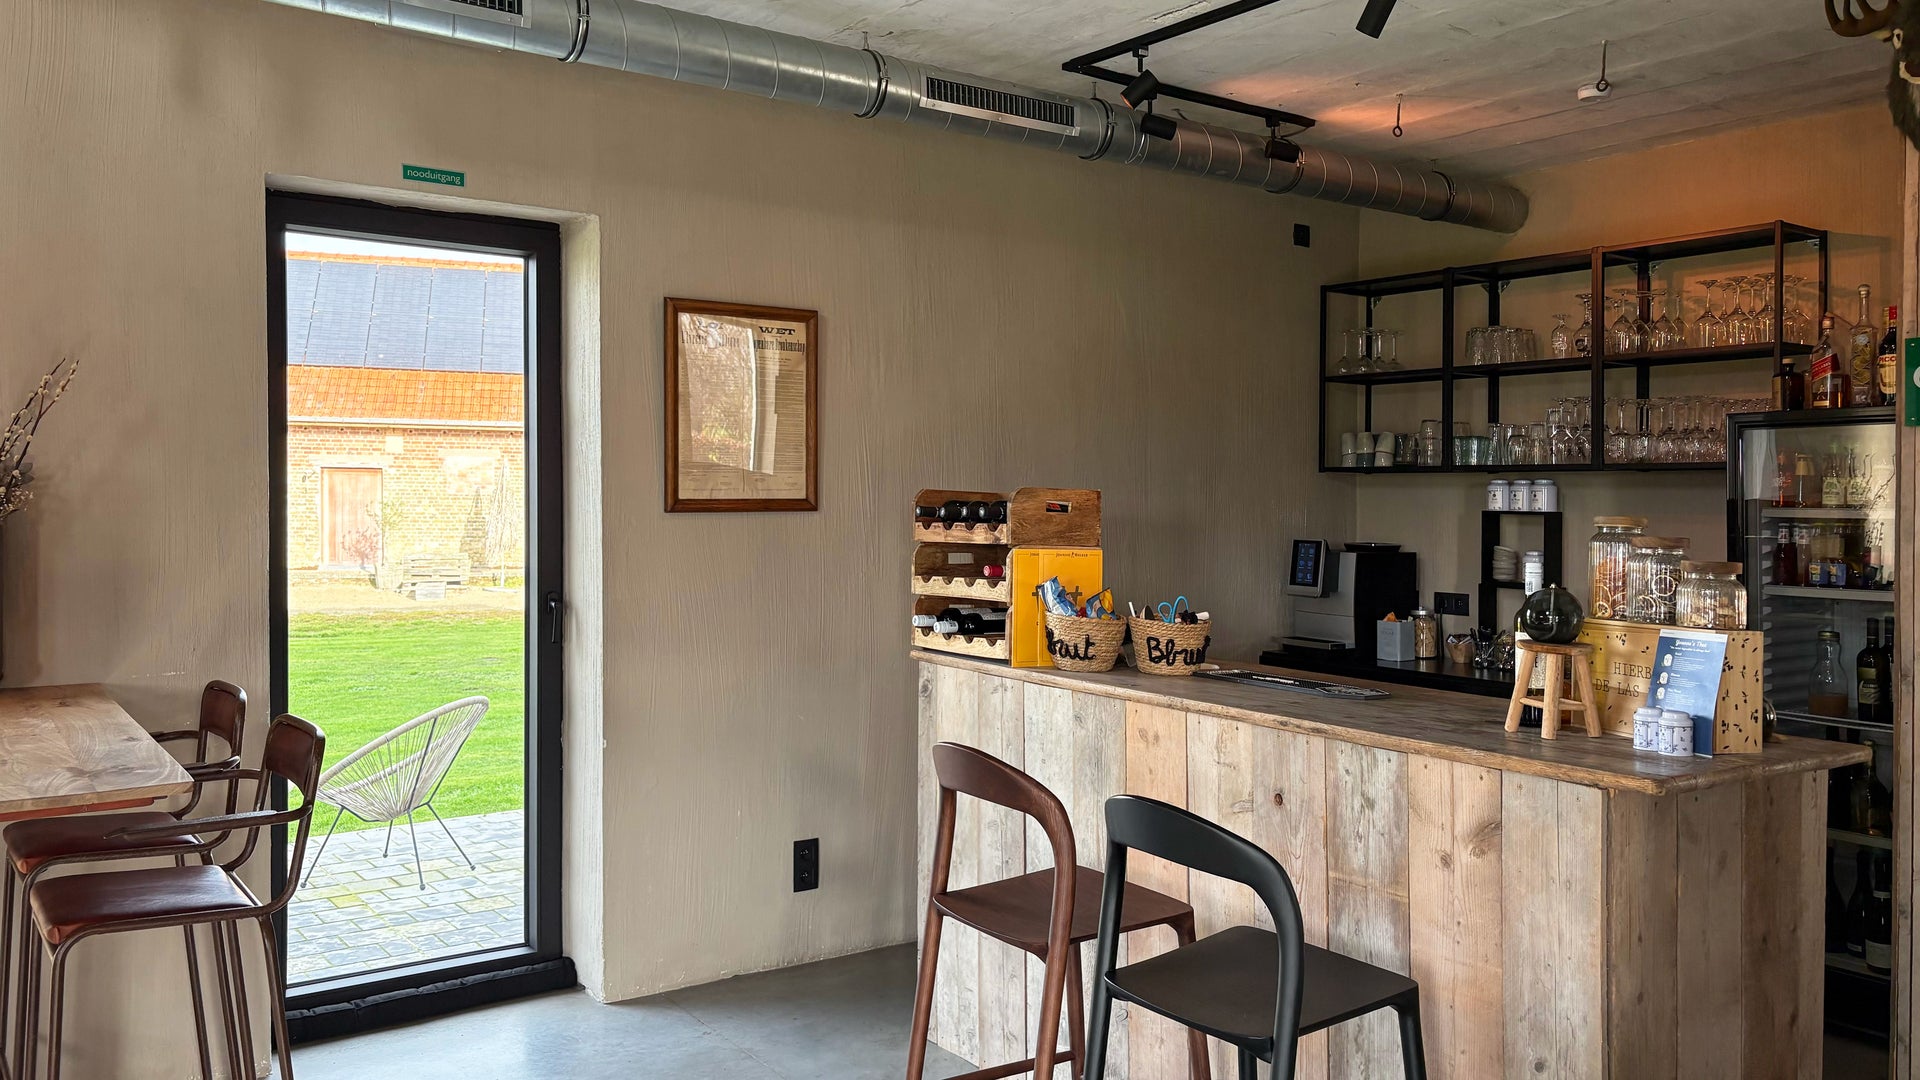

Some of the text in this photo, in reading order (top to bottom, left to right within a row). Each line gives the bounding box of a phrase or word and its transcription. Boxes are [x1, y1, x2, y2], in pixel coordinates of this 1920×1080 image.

[407, 169, 461, 185] nooduitgang
[758, 326, 796, 336] WET
[1613, 661, 1653, 680] HIERB
[1595, 678, 1640, 698] DE LAS
